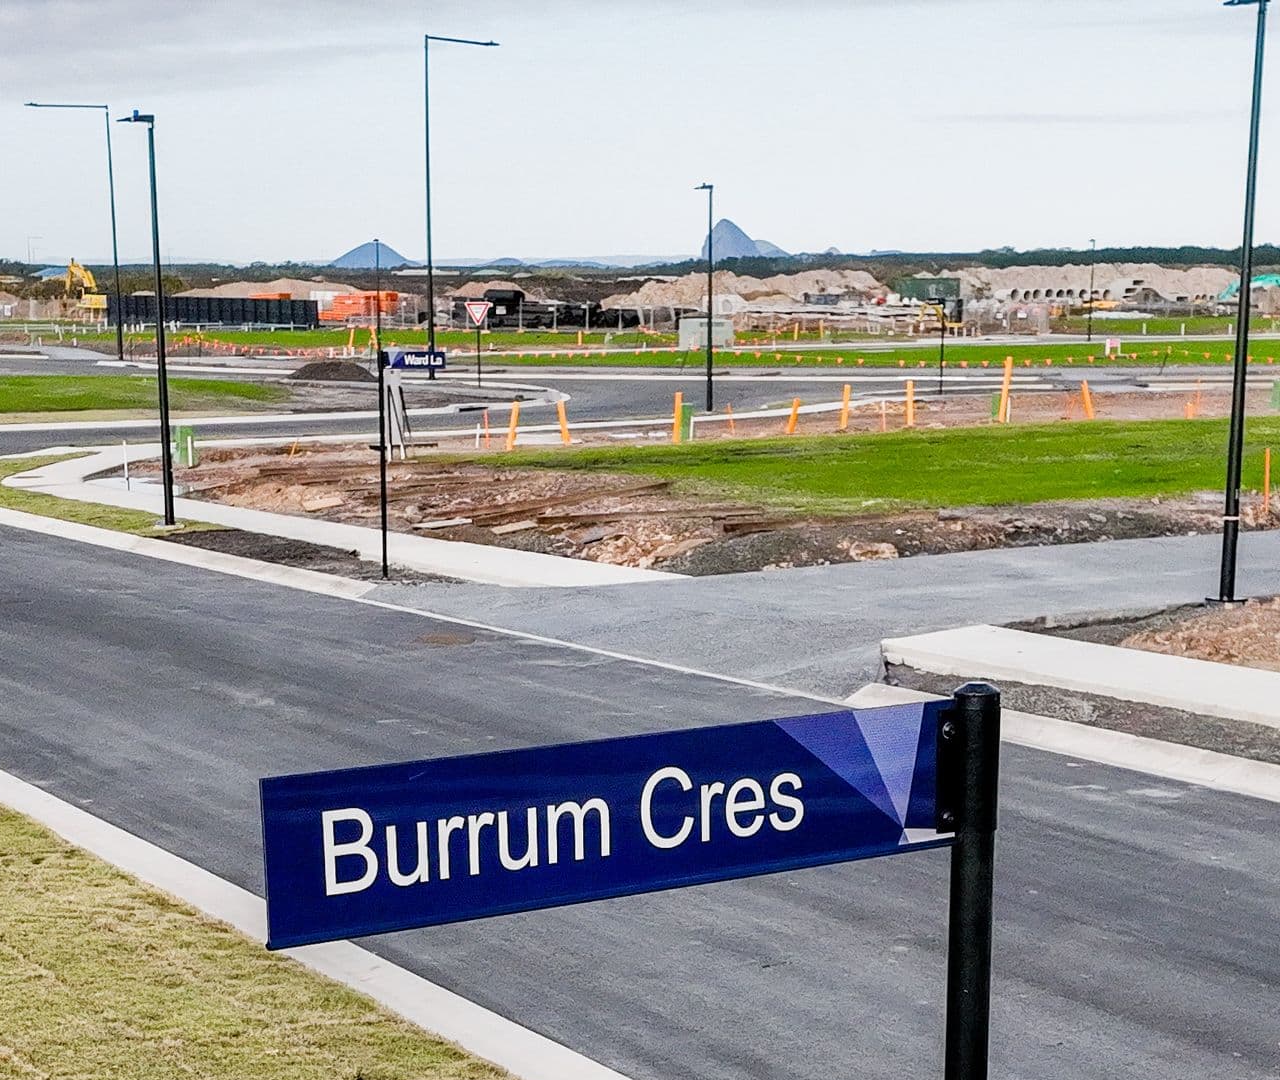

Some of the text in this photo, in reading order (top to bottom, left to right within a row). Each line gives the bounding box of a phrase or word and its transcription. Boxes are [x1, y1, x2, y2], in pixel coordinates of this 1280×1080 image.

[404, 354, 429, 365] Ward
[322, 767, 805, 897] Burrum Cres
